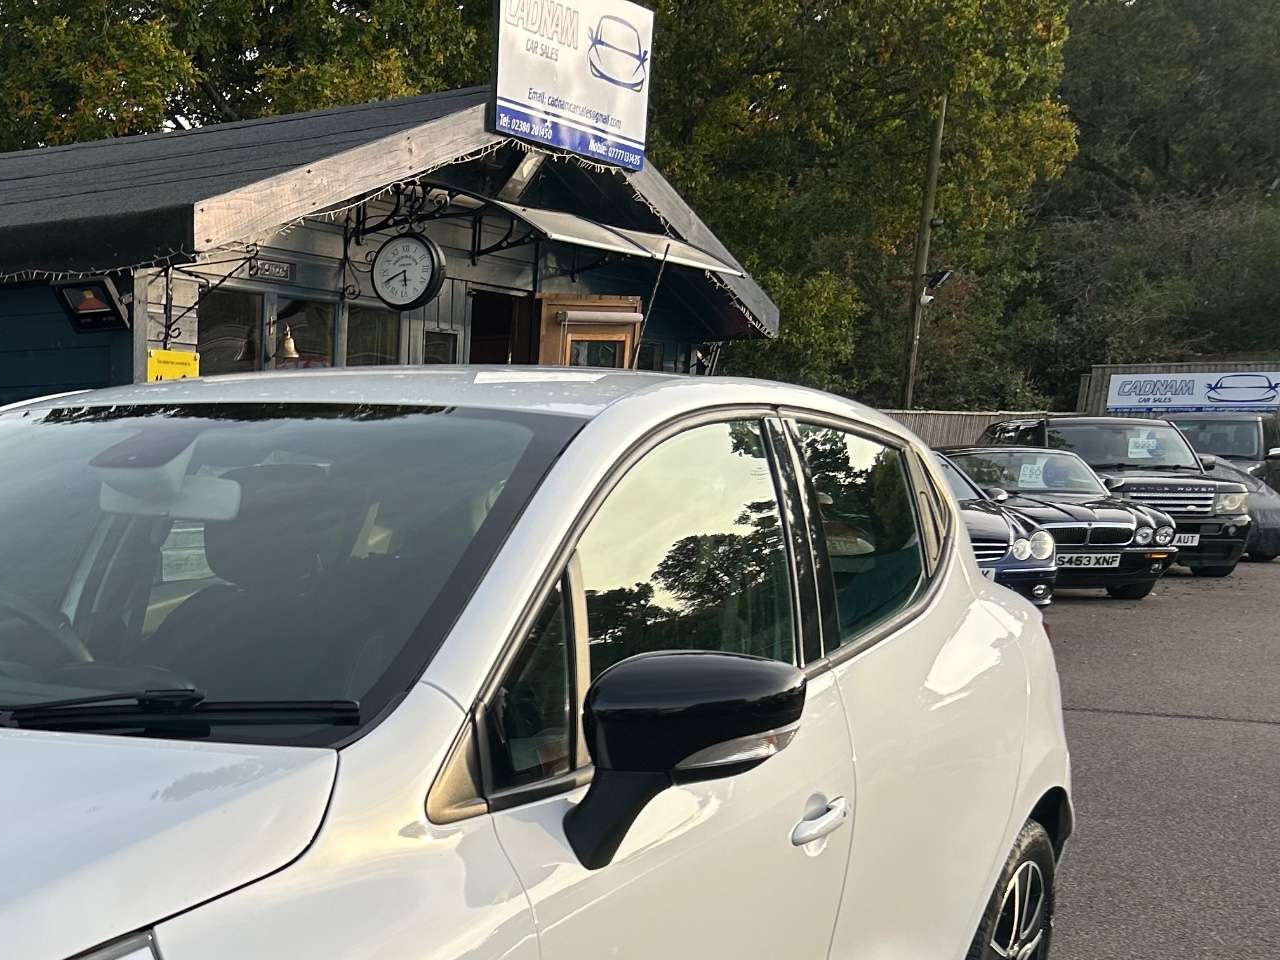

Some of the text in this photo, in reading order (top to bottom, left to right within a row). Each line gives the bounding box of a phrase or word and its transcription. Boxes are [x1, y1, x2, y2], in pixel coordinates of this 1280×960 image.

[504, 0, 579, 50] CADNAM
[526, 39, 559, 62] CAR SALES
[528, 87, 547, 106] Email:
[499, 113, 553, 140] Tel: 02380 201450
[589, 139, 607, 157] Mobile:
[1118, 380, 1195, 396] CADNAM
[1176, 535, 1197, 545] AUT
[1056, 555, 1120, 567] S453 XNF
